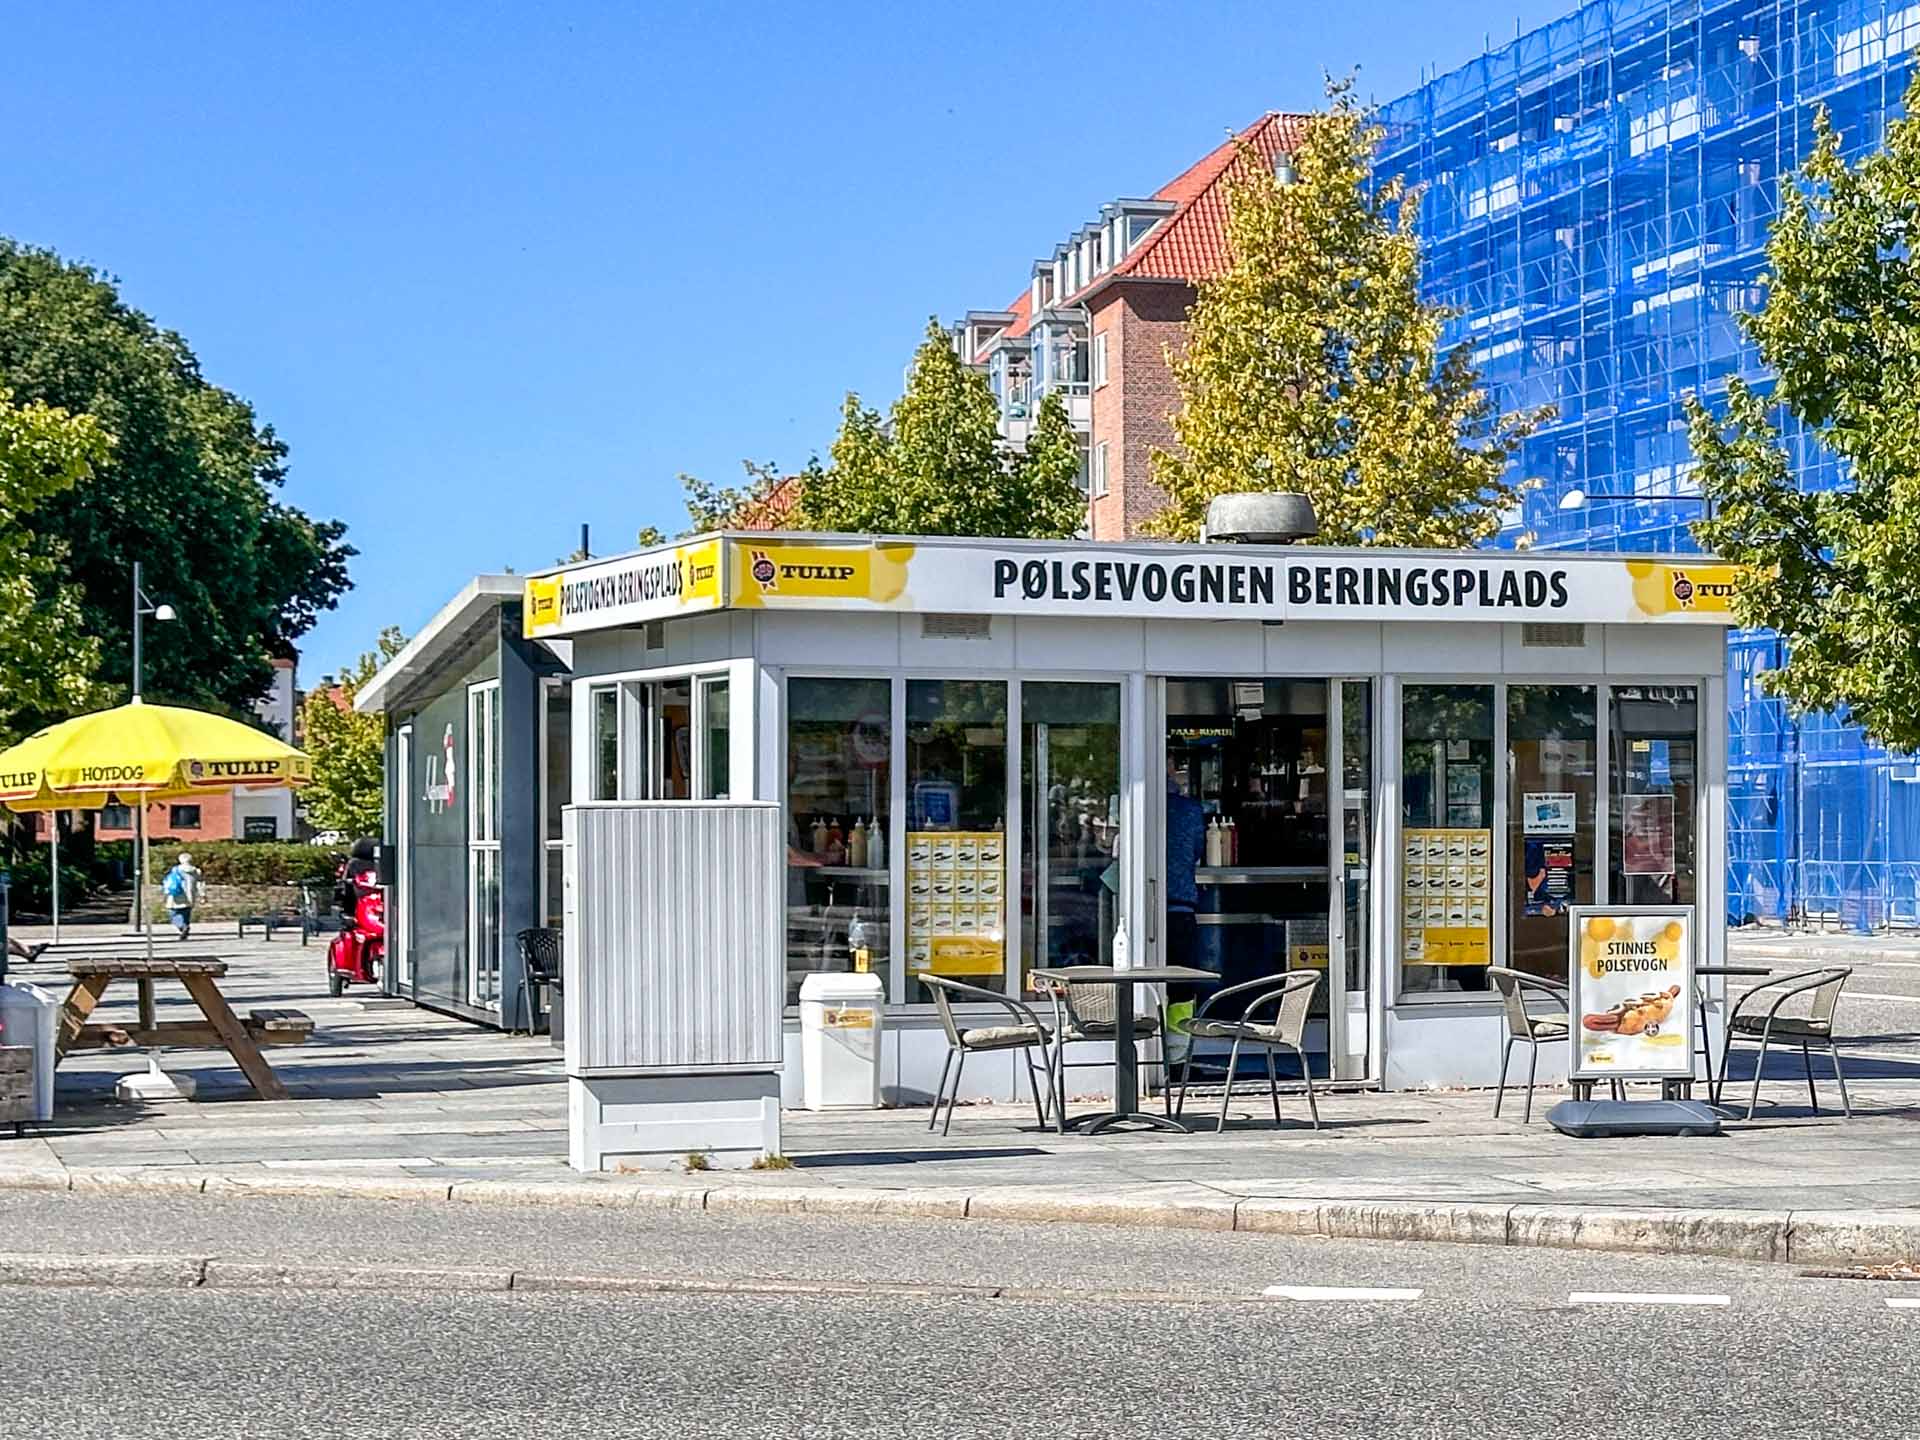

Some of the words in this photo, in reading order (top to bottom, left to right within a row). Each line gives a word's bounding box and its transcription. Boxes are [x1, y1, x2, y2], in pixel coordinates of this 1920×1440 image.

[780, 564, 854, 580] TULIP
[618, 560, 683, 605] BERINGSPLADS
[994, 559, 1274, 604] PØLSEVOGNEN
[1287, 565, 1568, 608] BERINGSPLADS
[1697, 584, 1736, 596] TUL
[81, 765, 144, 781] HOTDOG
[209, 760, 280, 776] TULIP
[0, 772, 37, 788] ULIP
[1607, 941, 1657, 955] STINNES
[1597, 958, 1668, 972] PØLSEVOGN
